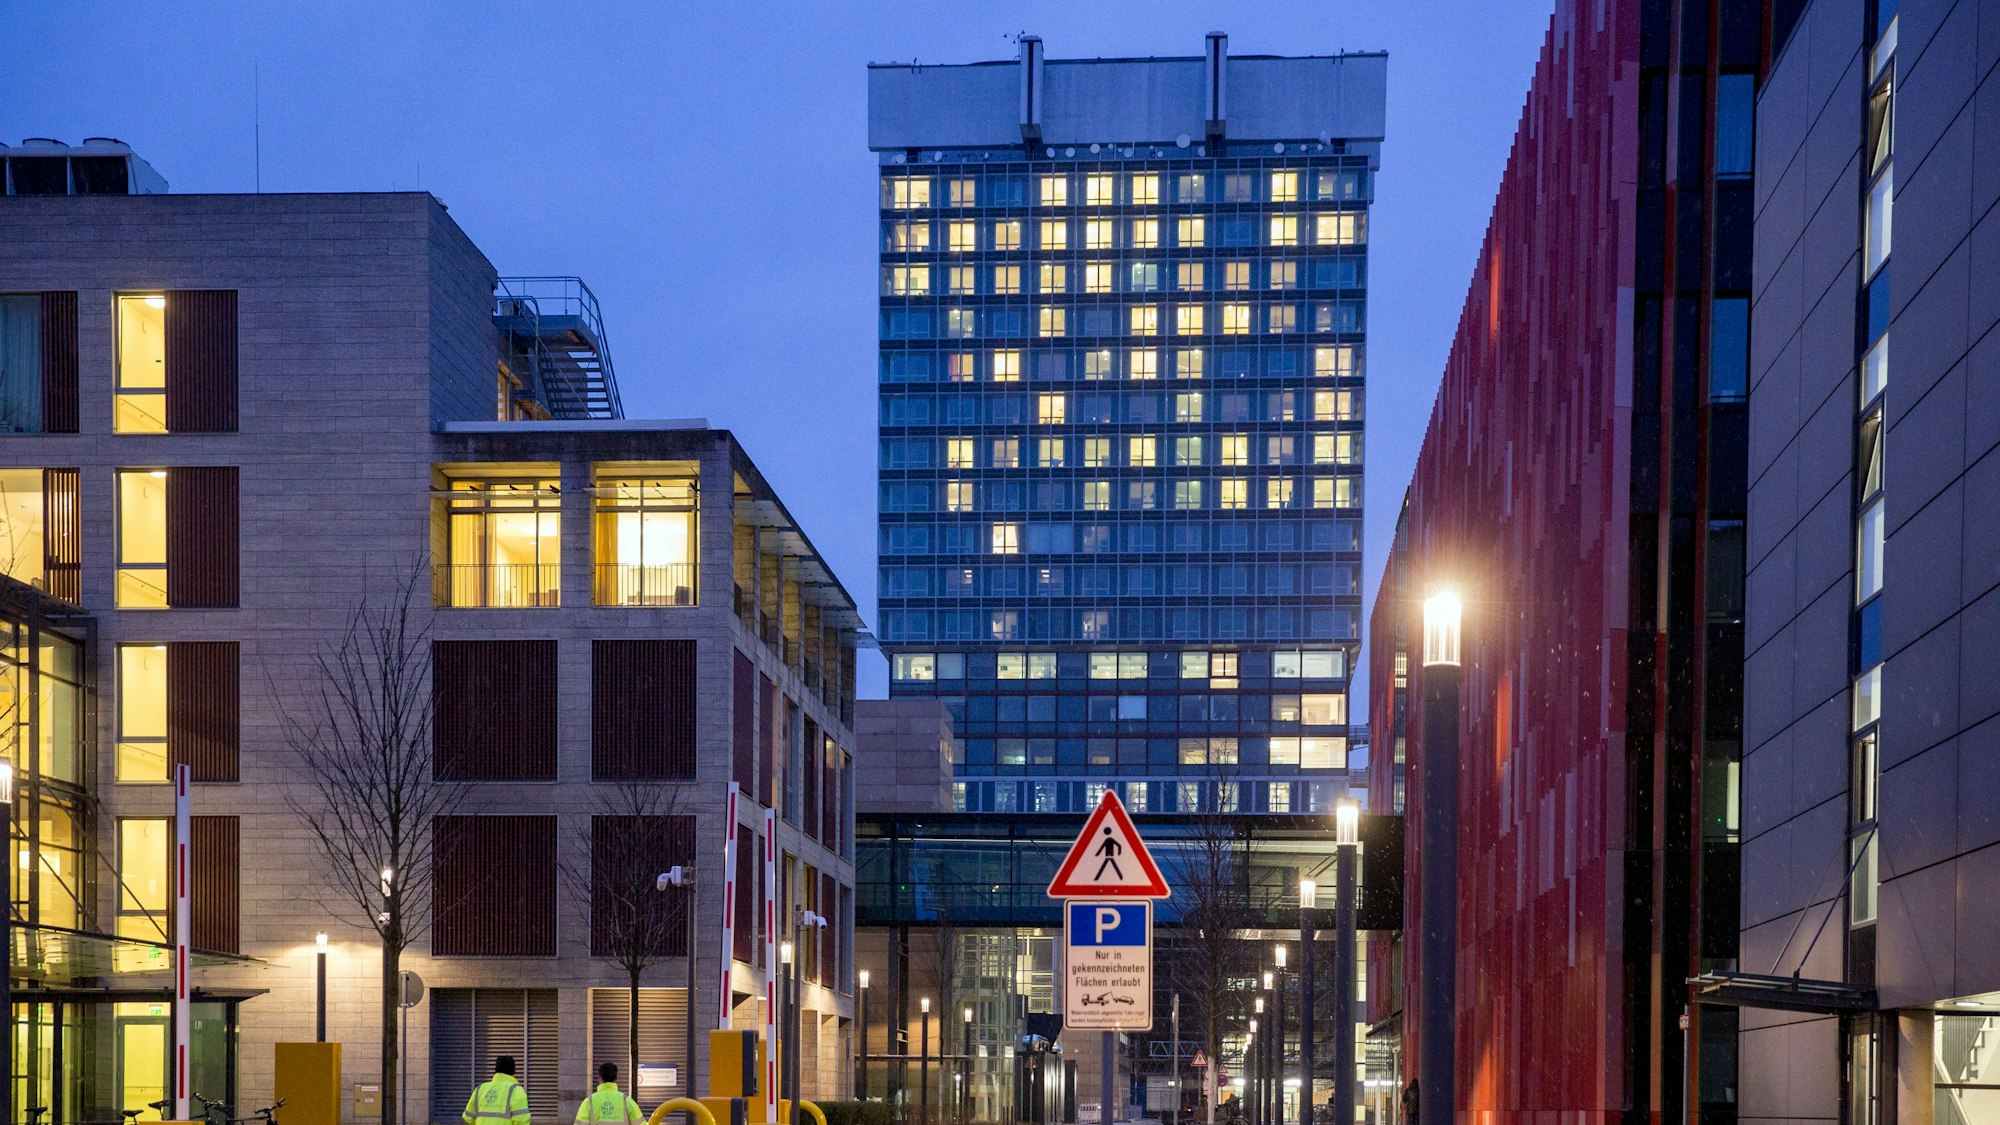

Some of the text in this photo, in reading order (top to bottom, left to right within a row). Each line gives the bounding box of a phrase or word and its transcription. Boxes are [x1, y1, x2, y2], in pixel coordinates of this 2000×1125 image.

[1096, 908, 1121, 944] P
[1095, 950, 1122, 960] Nur in
[1072, 963, 1145, 975] gekennzeichneten
[1075, 976, 1141, 987] Flächen erlaubt
